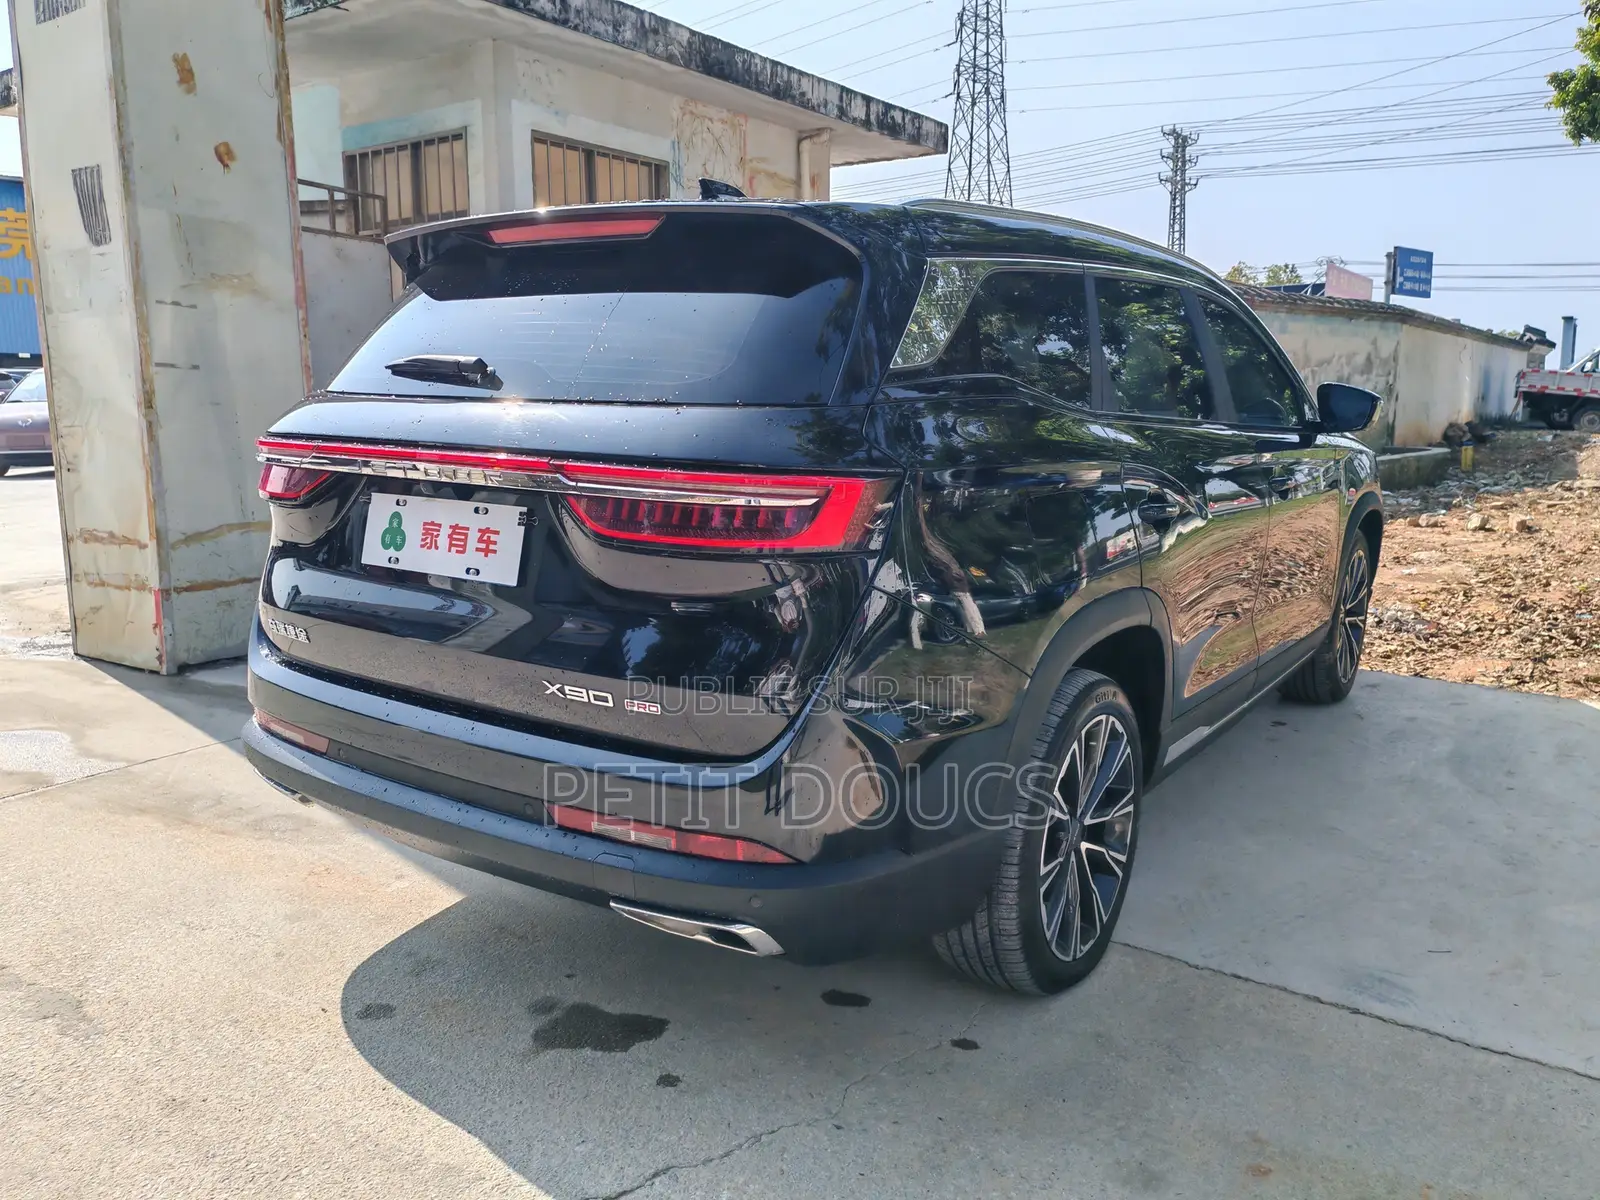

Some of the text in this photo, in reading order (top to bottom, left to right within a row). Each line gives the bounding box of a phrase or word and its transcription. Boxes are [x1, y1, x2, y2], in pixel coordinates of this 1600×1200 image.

[420, 520, 500, 557] 家有车
[541, 680, 661, 715] X90 PRO
